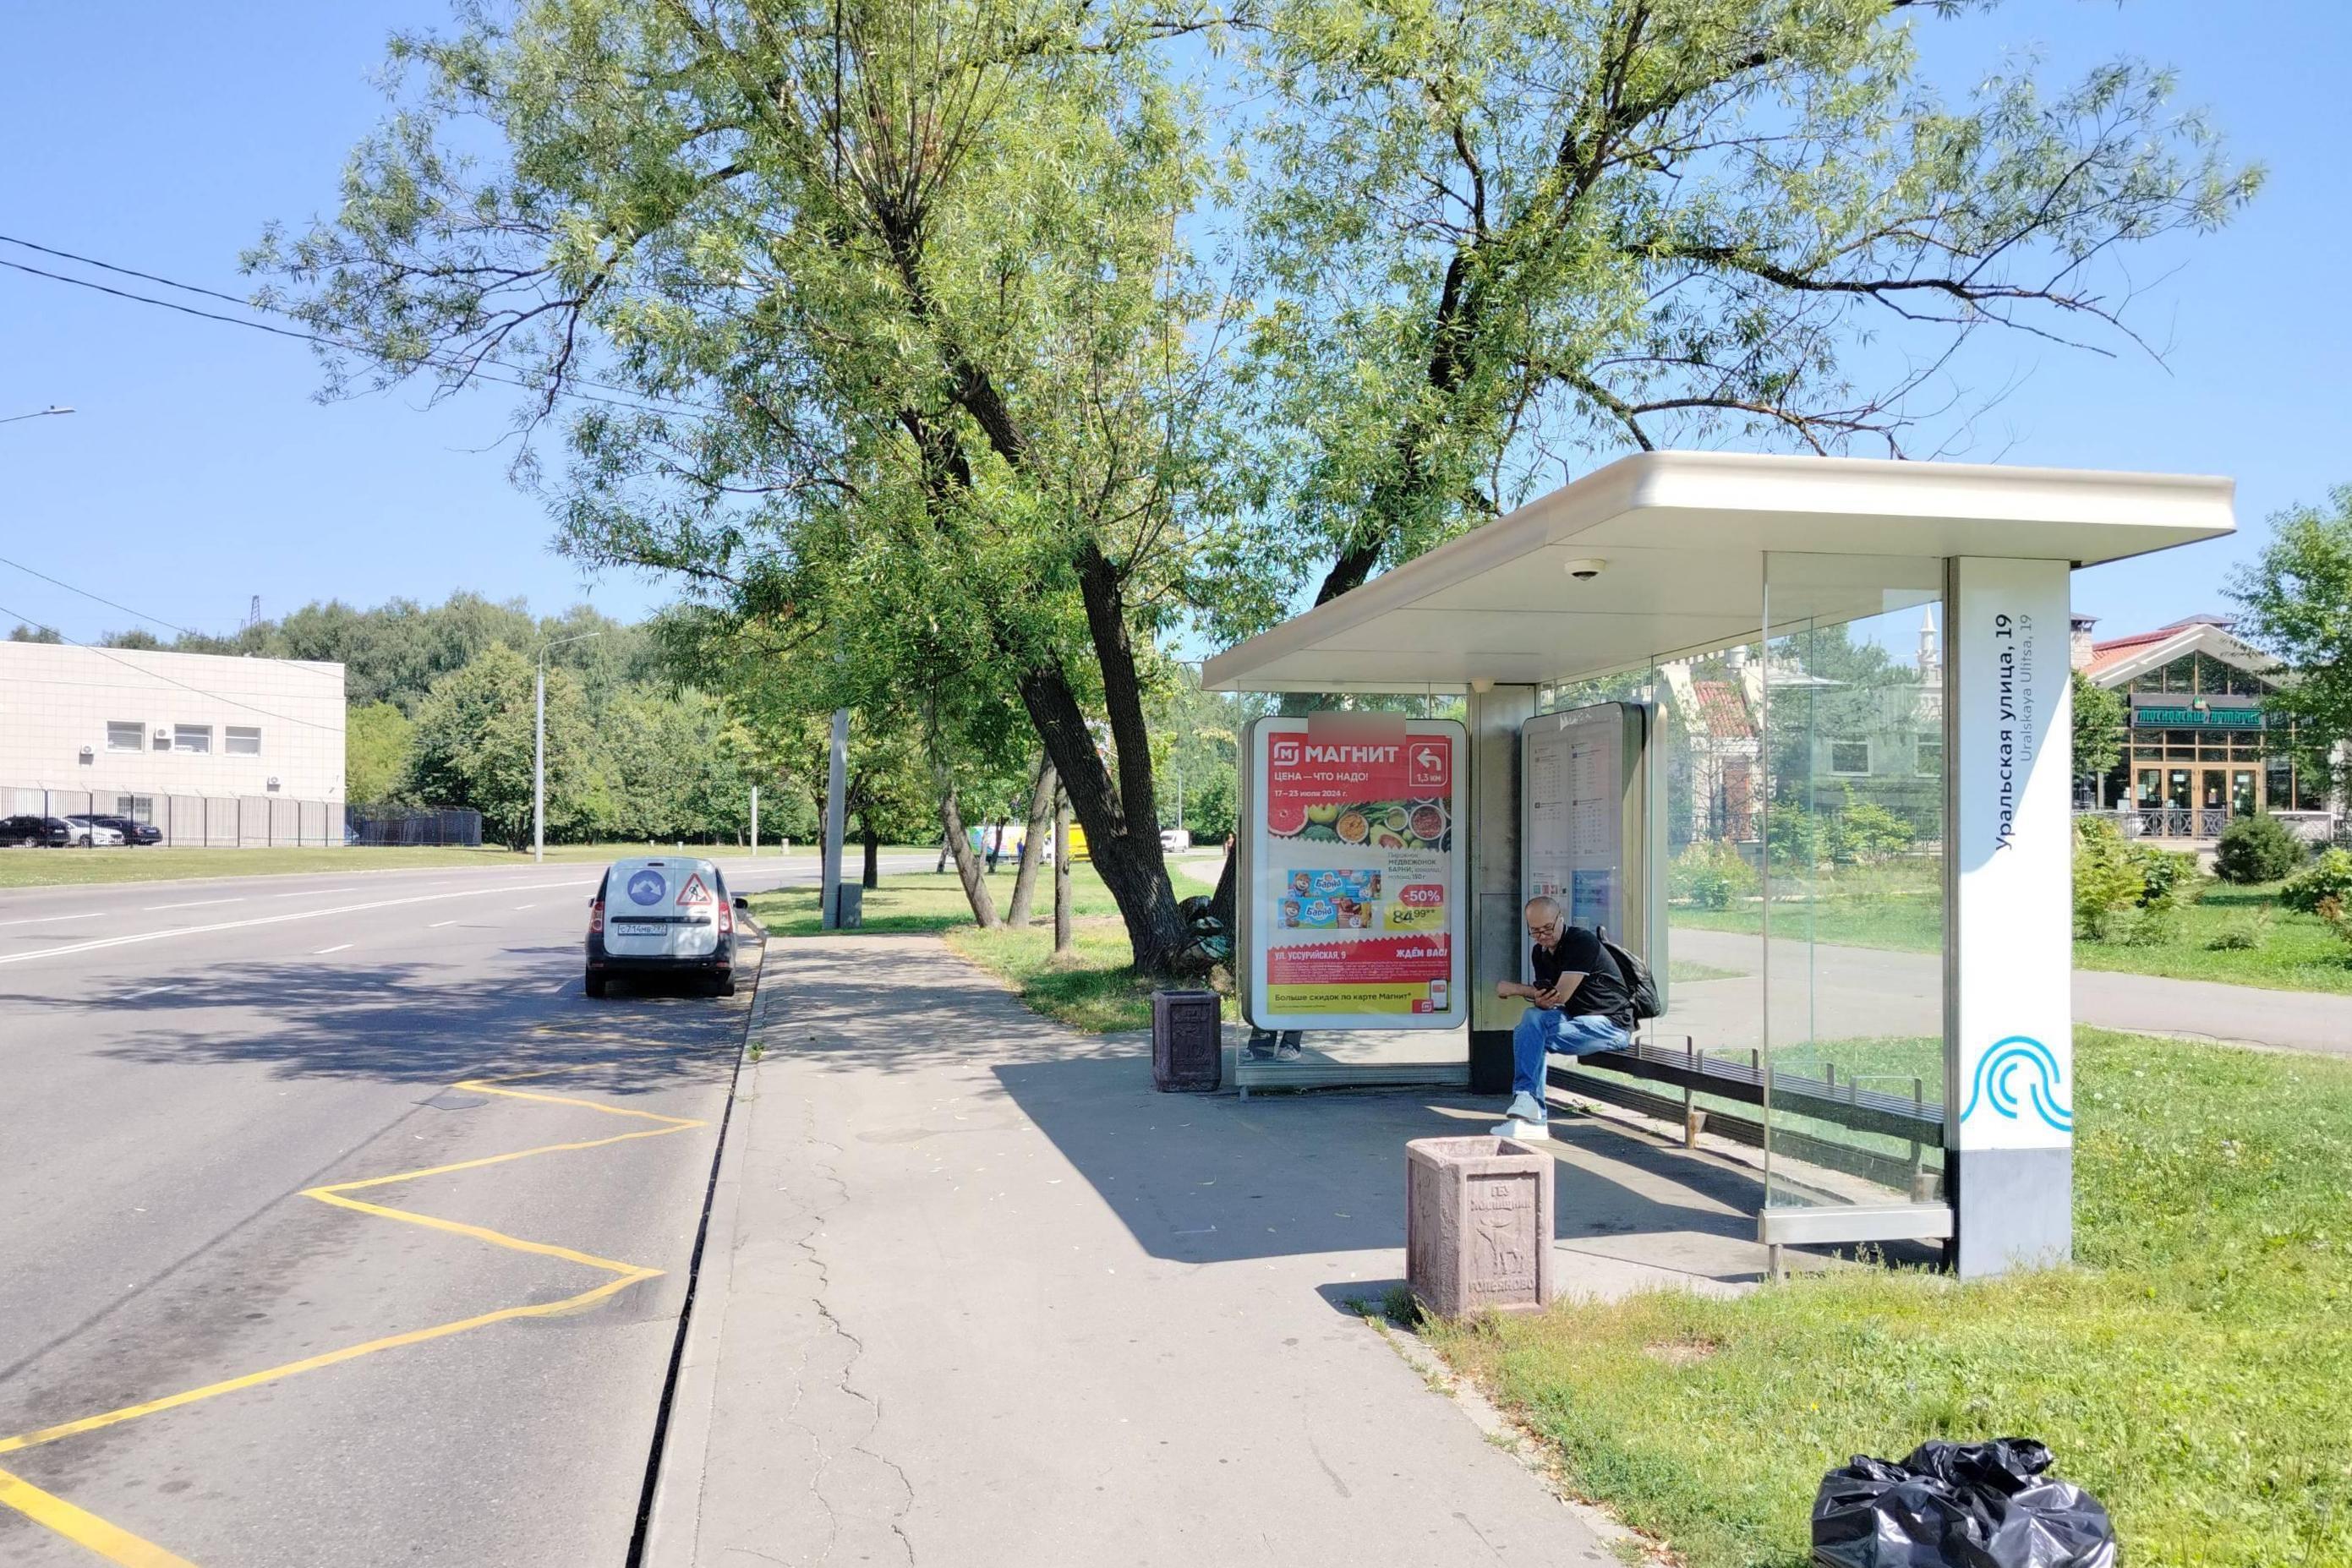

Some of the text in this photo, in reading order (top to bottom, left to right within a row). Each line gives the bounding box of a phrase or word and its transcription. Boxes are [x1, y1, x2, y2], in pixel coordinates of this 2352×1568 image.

[2020, 615, 2034, 761] Uralskaya Ulitsa, 19
[1995, 614, 2016, 851] Уральская улица, 19
[1305, 746, 1399, 762] МАГНИТ
[1274, 772, 1302, 782] ЦЕНА
[1313, 772, 1334, 780] ЧТО
[1336, 772, 1369, 783] НАДО!
[1315, 879, 1342, 888] Барни
[1403, 890, 1441, 902] -50%
[1306, 906, 1332, 916] Барни
[1341, 951, 1347, 959] 9
[1396, 947, 1447, 959] ЖДЁМ ВАС!
[1275, 993, 1308, 1002] Больше
